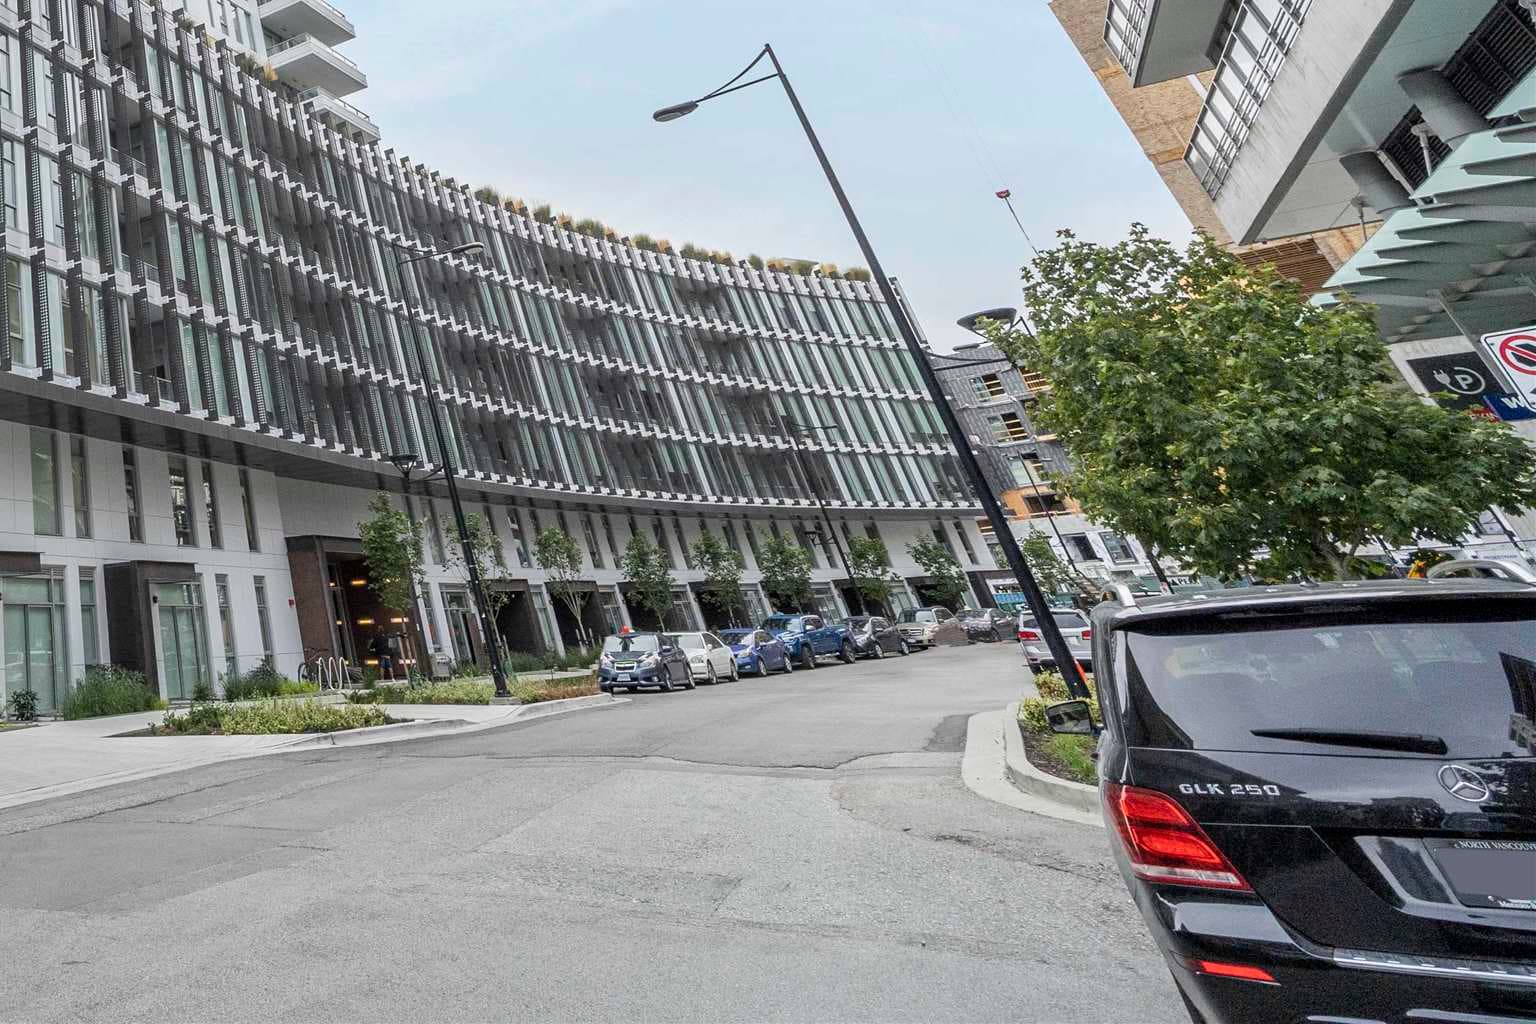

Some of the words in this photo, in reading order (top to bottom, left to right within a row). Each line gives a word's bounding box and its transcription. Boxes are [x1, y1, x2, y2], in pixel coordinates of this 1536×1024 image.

[1178, 783, 1225, 795] GLK
[1230, 783, 1281, 796] 250
[1459, 840, 1491, 849] NORTH
